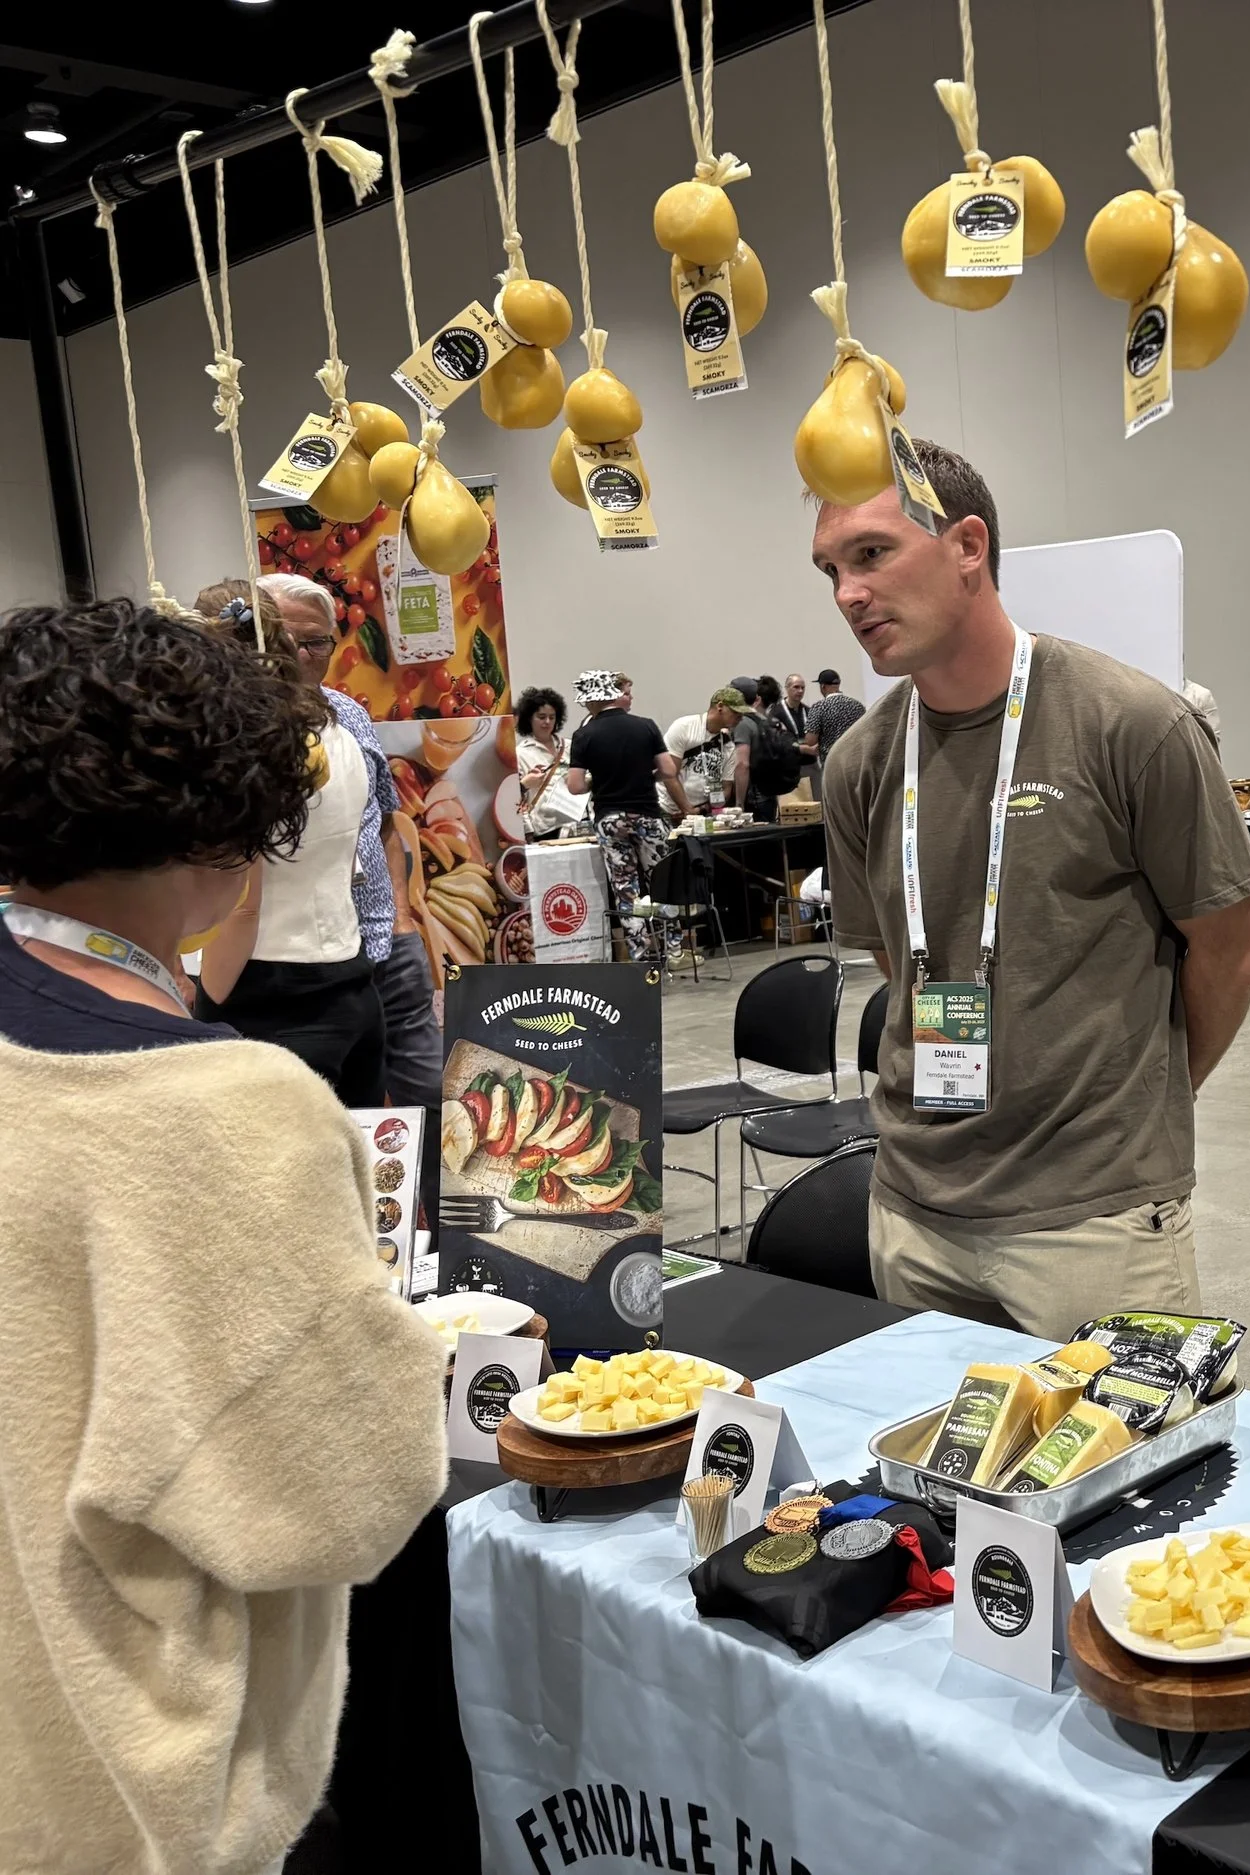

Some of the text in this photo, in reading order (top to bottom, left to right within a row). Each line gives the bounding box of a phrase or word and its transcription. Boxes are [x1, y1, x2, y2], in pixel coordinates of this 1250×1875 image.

[445, 330, 486, 370] FERNDALE FARMSTEAD
[702, 370, 726, 381] SMOKY
[401, 378, 432, 410] SCAMORZA
[413, 375, 435, 397] SMOKY
[702, 382, 739, 396] SCAMORZA
[606, 467, 637, 488] FARMSTEAD
[610, 543, 649, 551] SCAMORZA
[403, 595, 431, 610] FETA
[1022, 782, 1065, 800] FARMSTEAD
[480, 987, 622, 1026] FERNDALE FARMSTEAD
[514, 1038, 584, 1051] SEED TO CHEESE
[934, 1050, 967, 1059] DANIEL
[1130, 1370, 1176, 1387] MOZZARELLA
[945, 1422, 990, 1437] PARMESAN
[979, 1574, 1026, 1594] FERNDALE FARMSTEAD
[516, 1783, 715, 1875] FERNDALE
